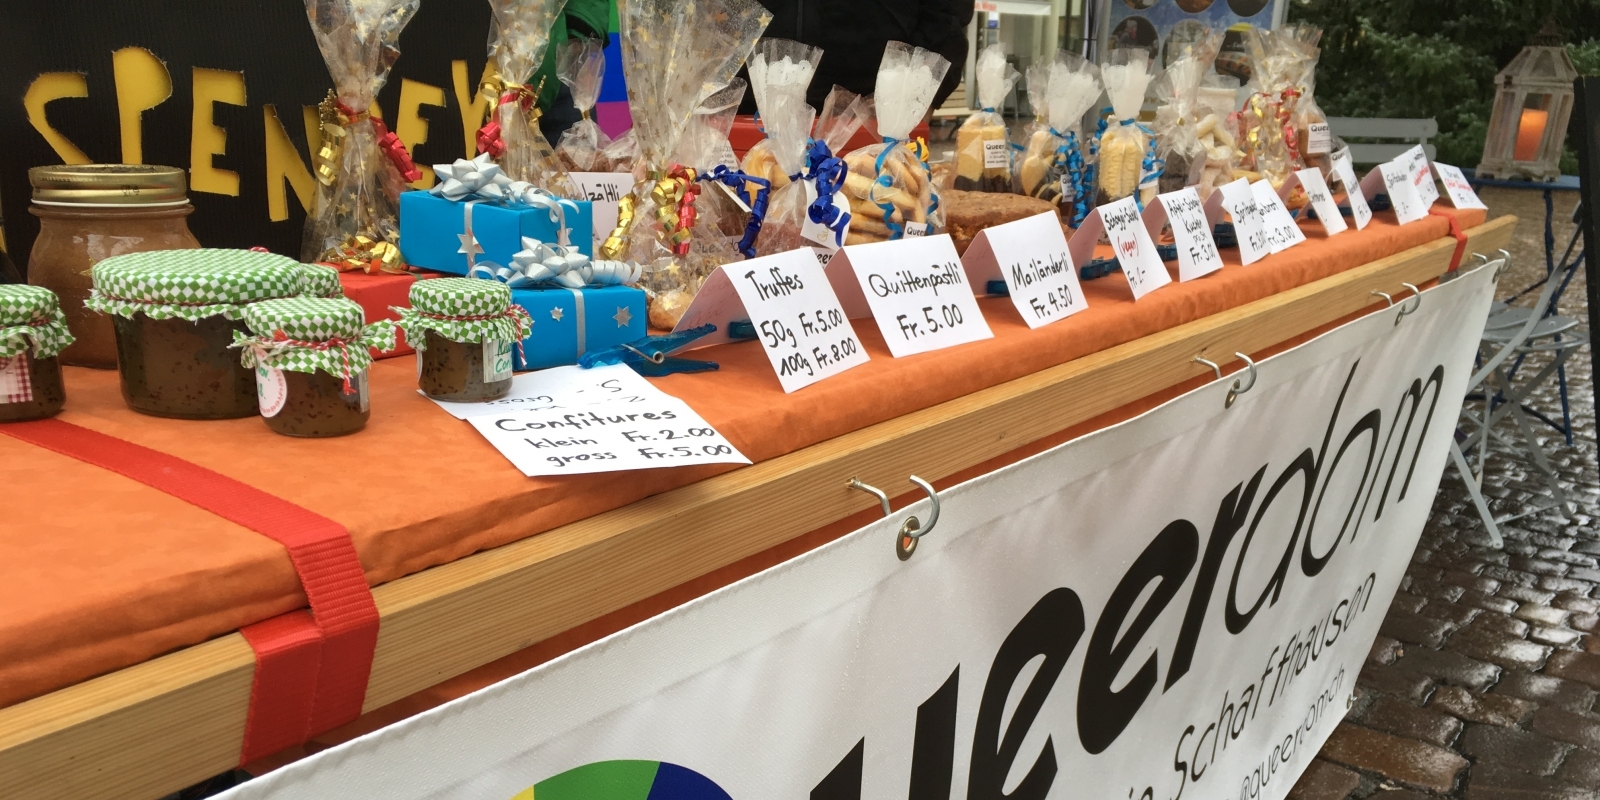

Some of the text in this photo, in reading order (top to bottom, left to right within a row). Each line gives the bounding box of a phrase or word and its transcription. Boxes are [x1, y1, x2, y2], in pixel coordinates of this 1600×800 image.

[745, 266, 804, 302] Truffes
[868, 262, 962, 298] Quittenpästli
[1011, 252, 1070, 291] Mailänderli
[760, 320, 798, 349] 50g
[780, 352, 815, 377] 100g
[495, 408, 678, 433] Confitures
[525, 438, 598, 450] klein
[547, 451, 617, 467] gross
[808, 364, 1444, 800] ueerdom
